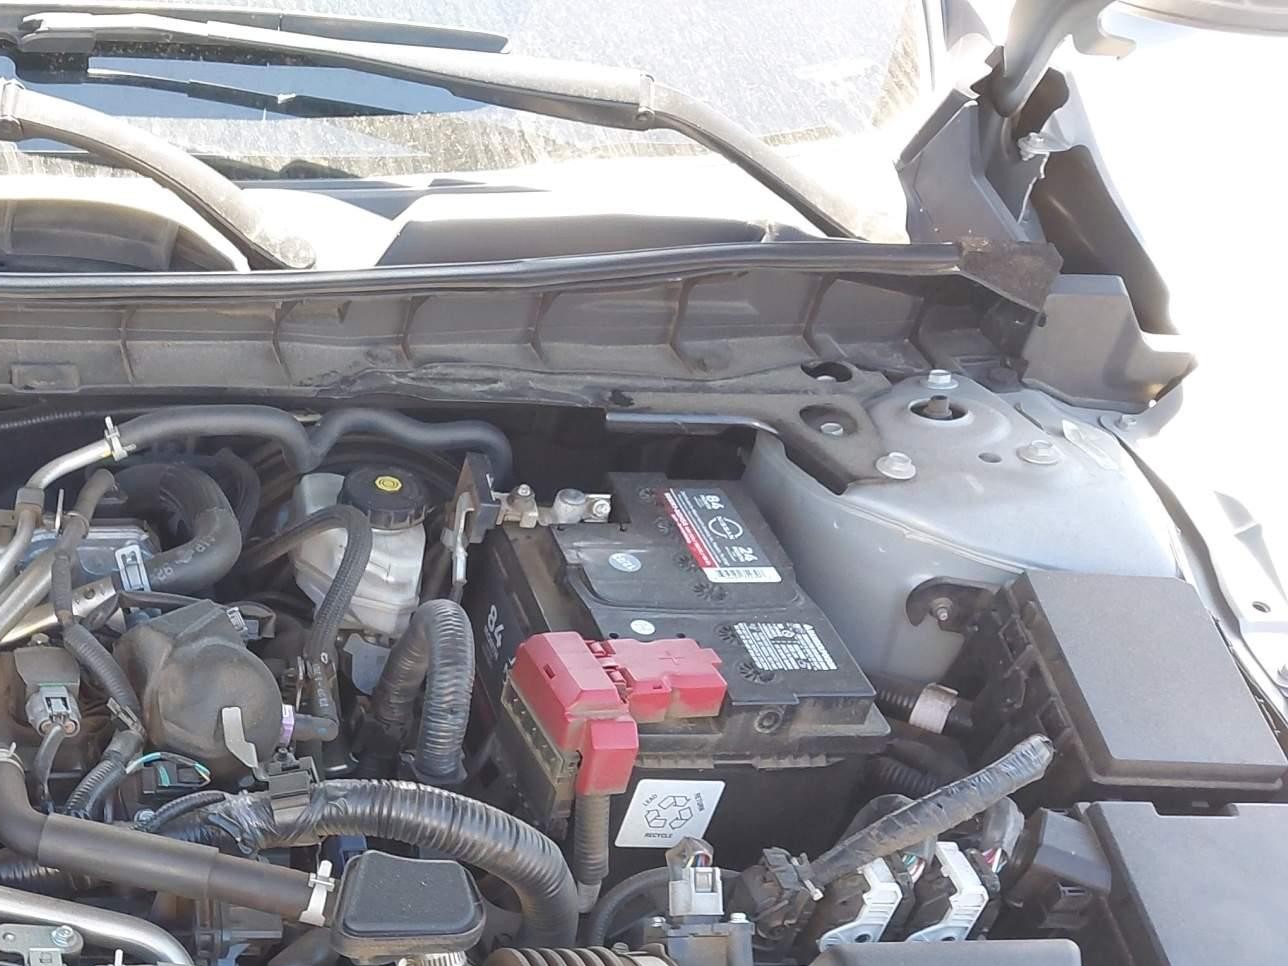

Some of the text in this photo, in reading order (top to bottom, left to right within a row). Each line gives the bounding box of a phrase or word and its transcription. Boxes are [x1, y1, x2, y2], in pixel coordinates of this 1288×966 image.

[705, 495, 724, 510] 84
[715, 516, 735, 540] NISSAN
[738, 546, 758, 562] 24
[488, 604, 505, 648] 84
[642, 793, 658, 807] LEAD
